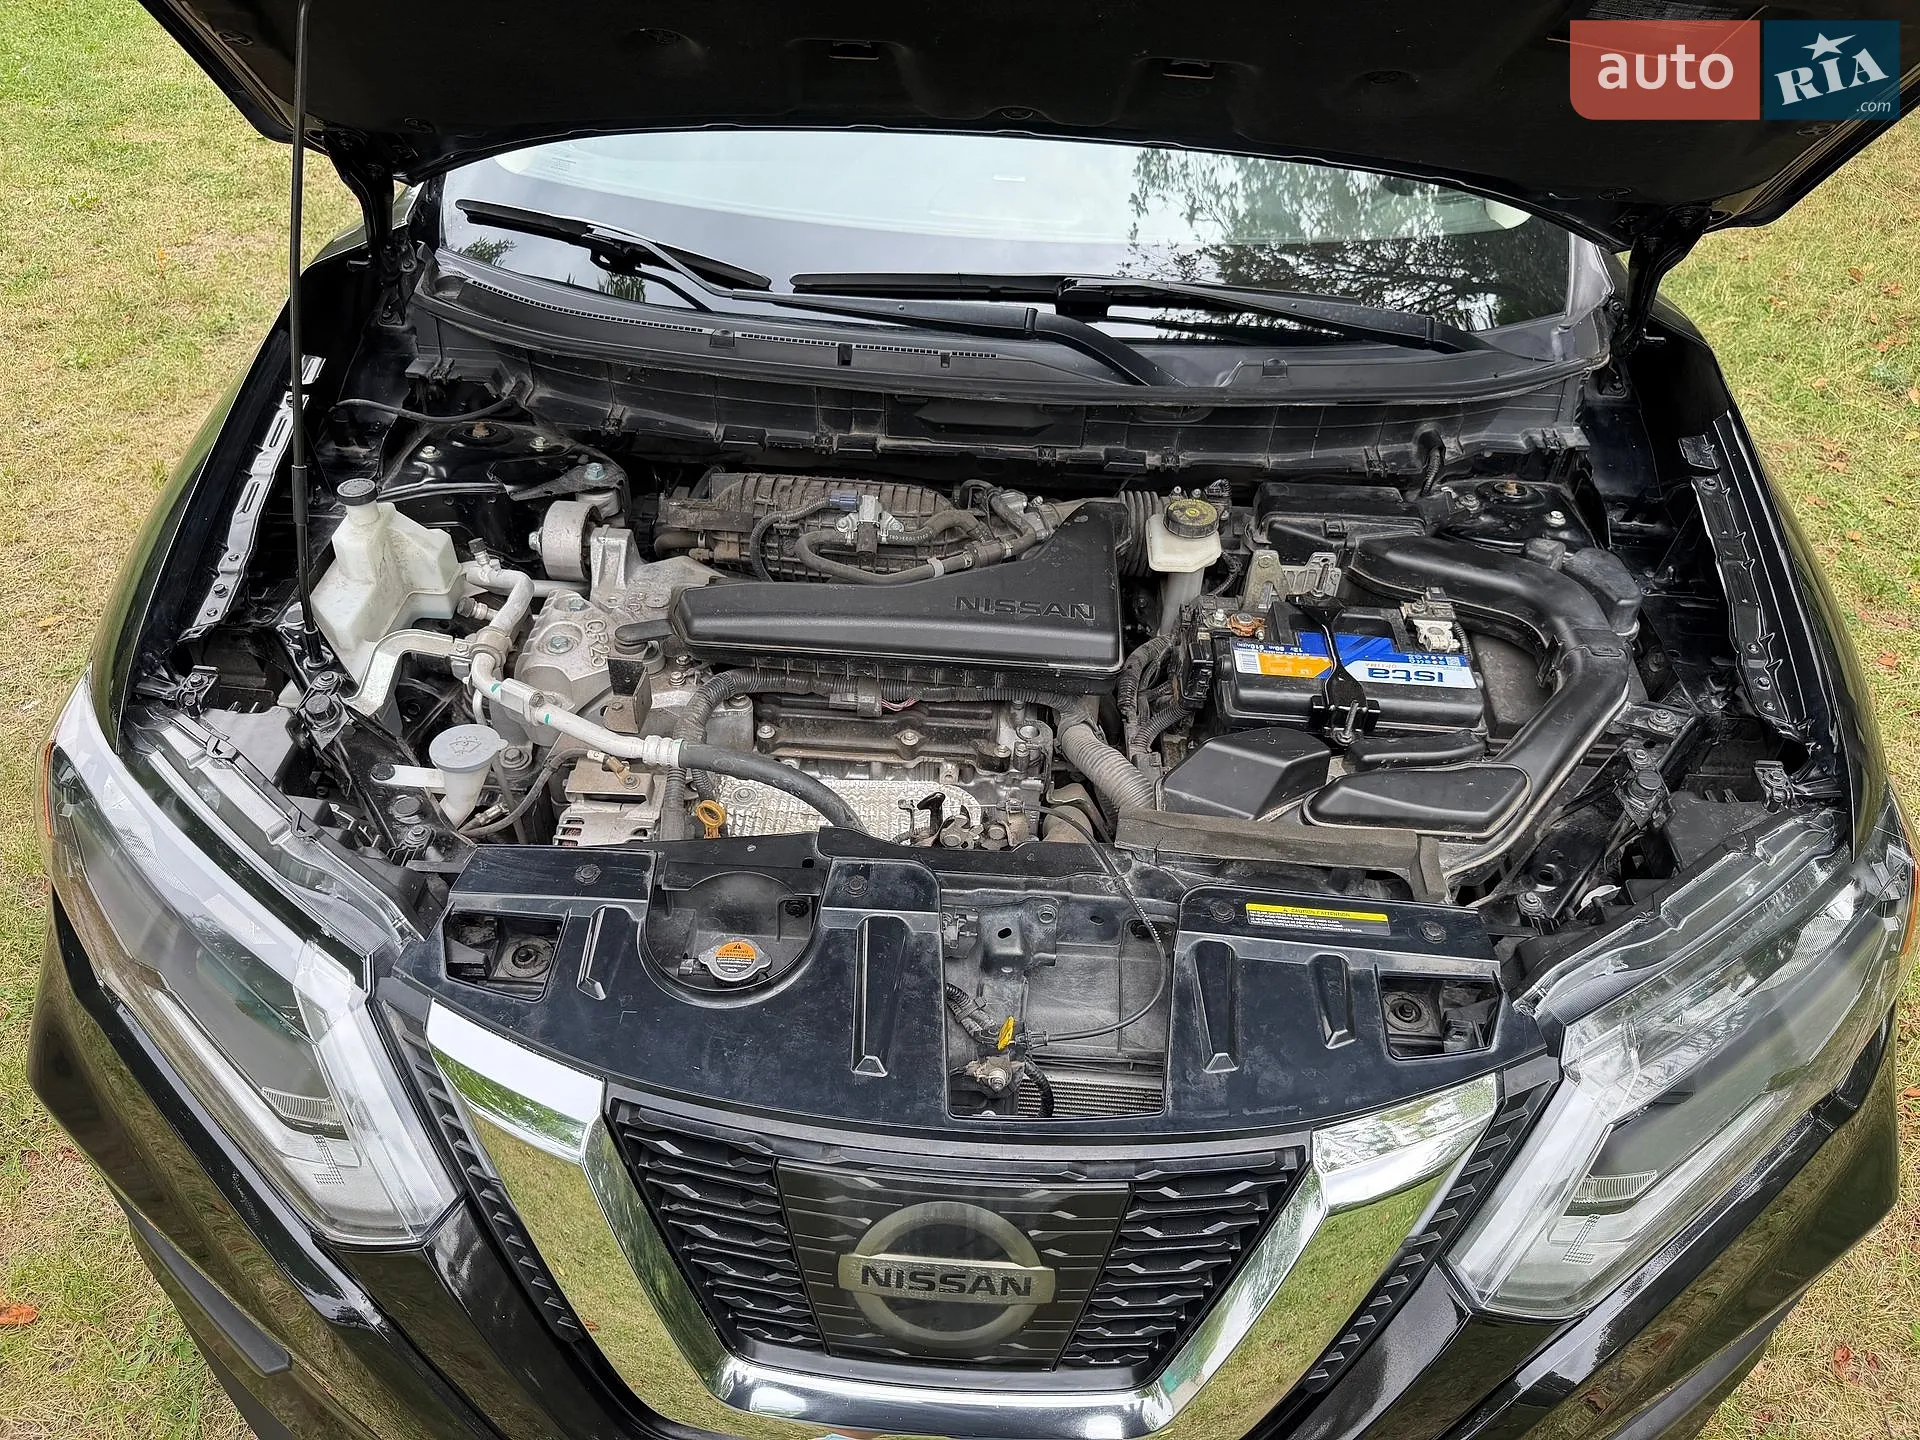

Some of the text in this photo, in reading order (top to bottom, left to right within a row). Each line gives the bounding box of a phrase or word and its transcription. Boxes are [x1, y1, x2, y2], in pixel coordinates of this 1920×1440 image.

[954, 594, 1096, 621] NISSAN
[586, 619, 611, 667] QR25
[1367, 667, 1444, 683] ista
[860, 1264, 1032, 1297] NISSAN
